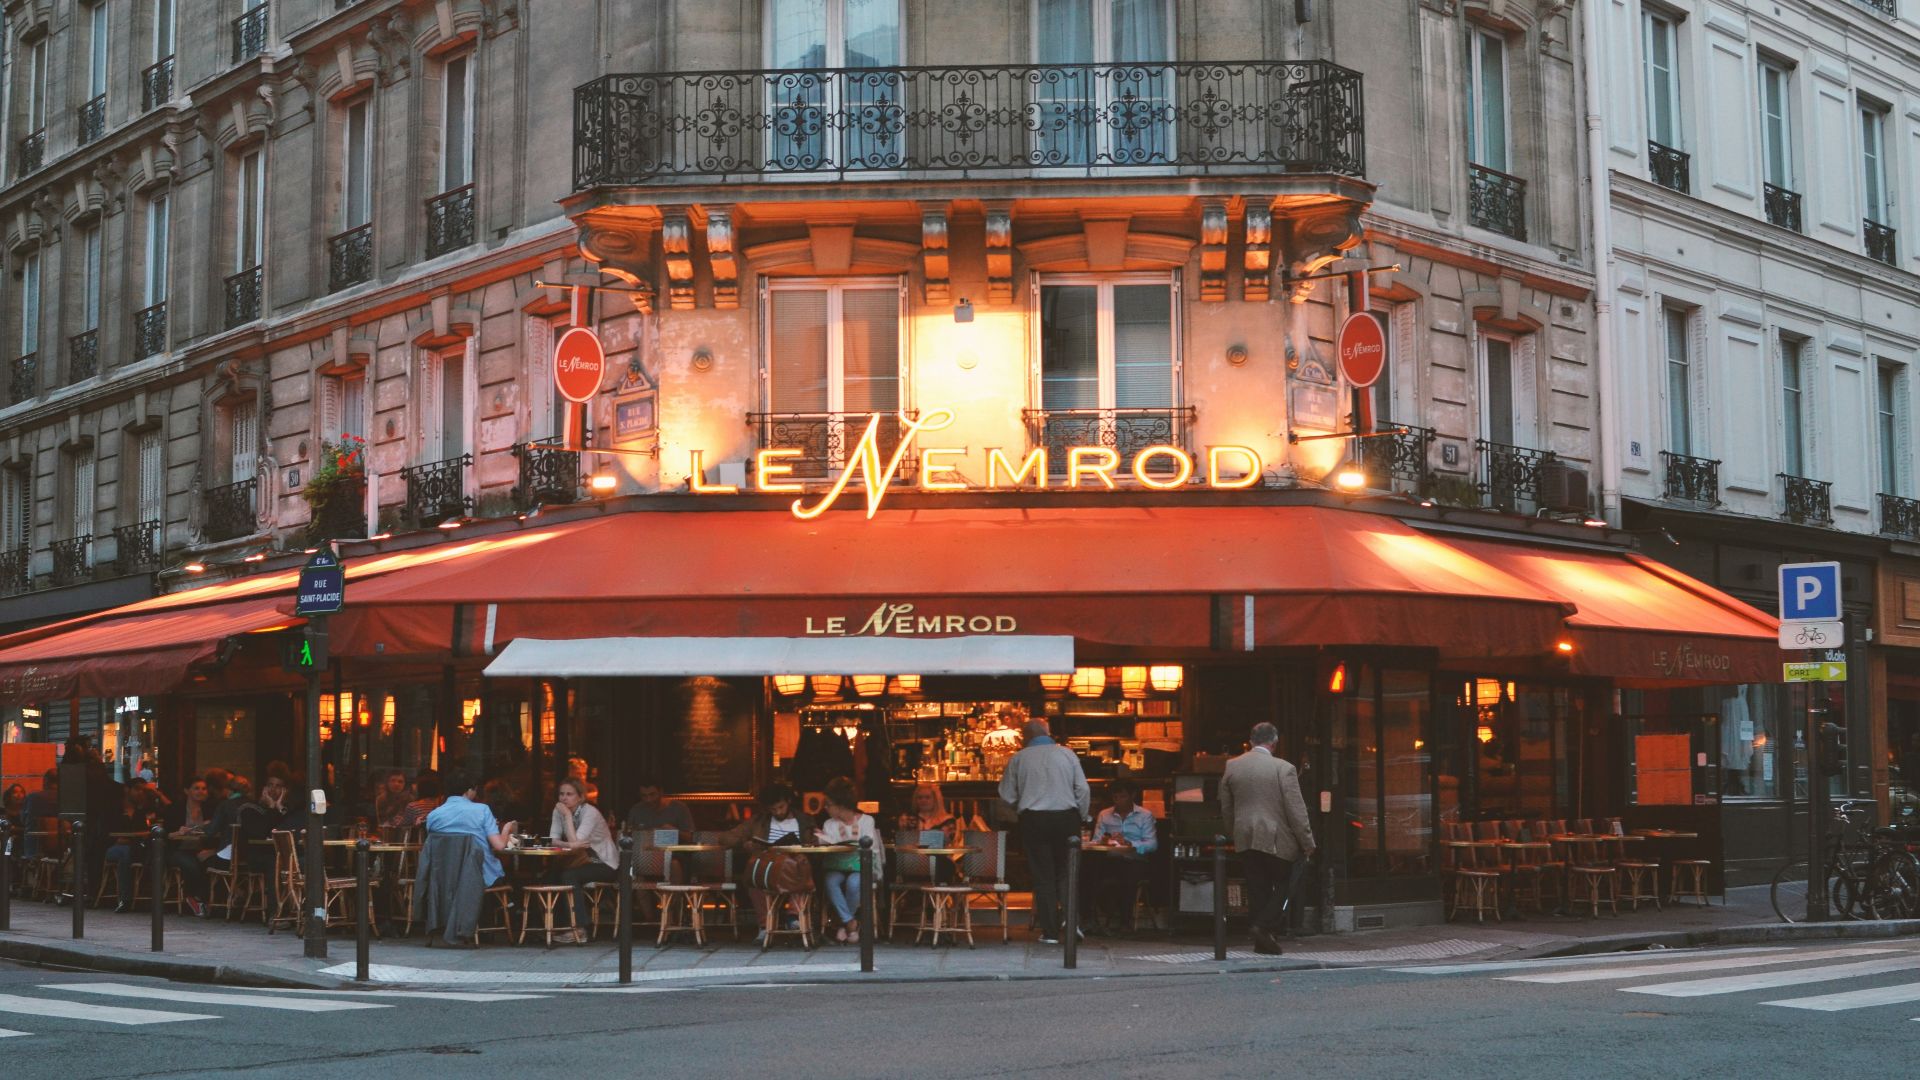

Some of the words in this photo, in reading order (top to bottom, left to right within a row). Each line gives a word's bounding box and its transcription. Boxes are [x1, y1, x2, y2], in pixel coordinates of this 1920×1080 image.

[1343, 347, 1351, 356] LE
[1349, 342, 1381, 360] NEMROD
[559, 359, 568, 368] LE
[564, 356, 599, 373] NEMROD
[689, 448, 804, 494] LE
[791, 407, 1263, 519] NEMROD
[1446, 446, 1456, 463] 51
[290, 471, 299, 486] 30
[313, 579, 327, 589] RUE
[300, 592, 341, 604] SAINT-PLACIDE
[1796, 575, 1822, 611] P
[806, 616, 846, 634] LE
[840, 602, 1017, 637] NEMROD
[1652, 650, 1668, 667] LE
[1664, 641, 1730, 676] NEMROD
